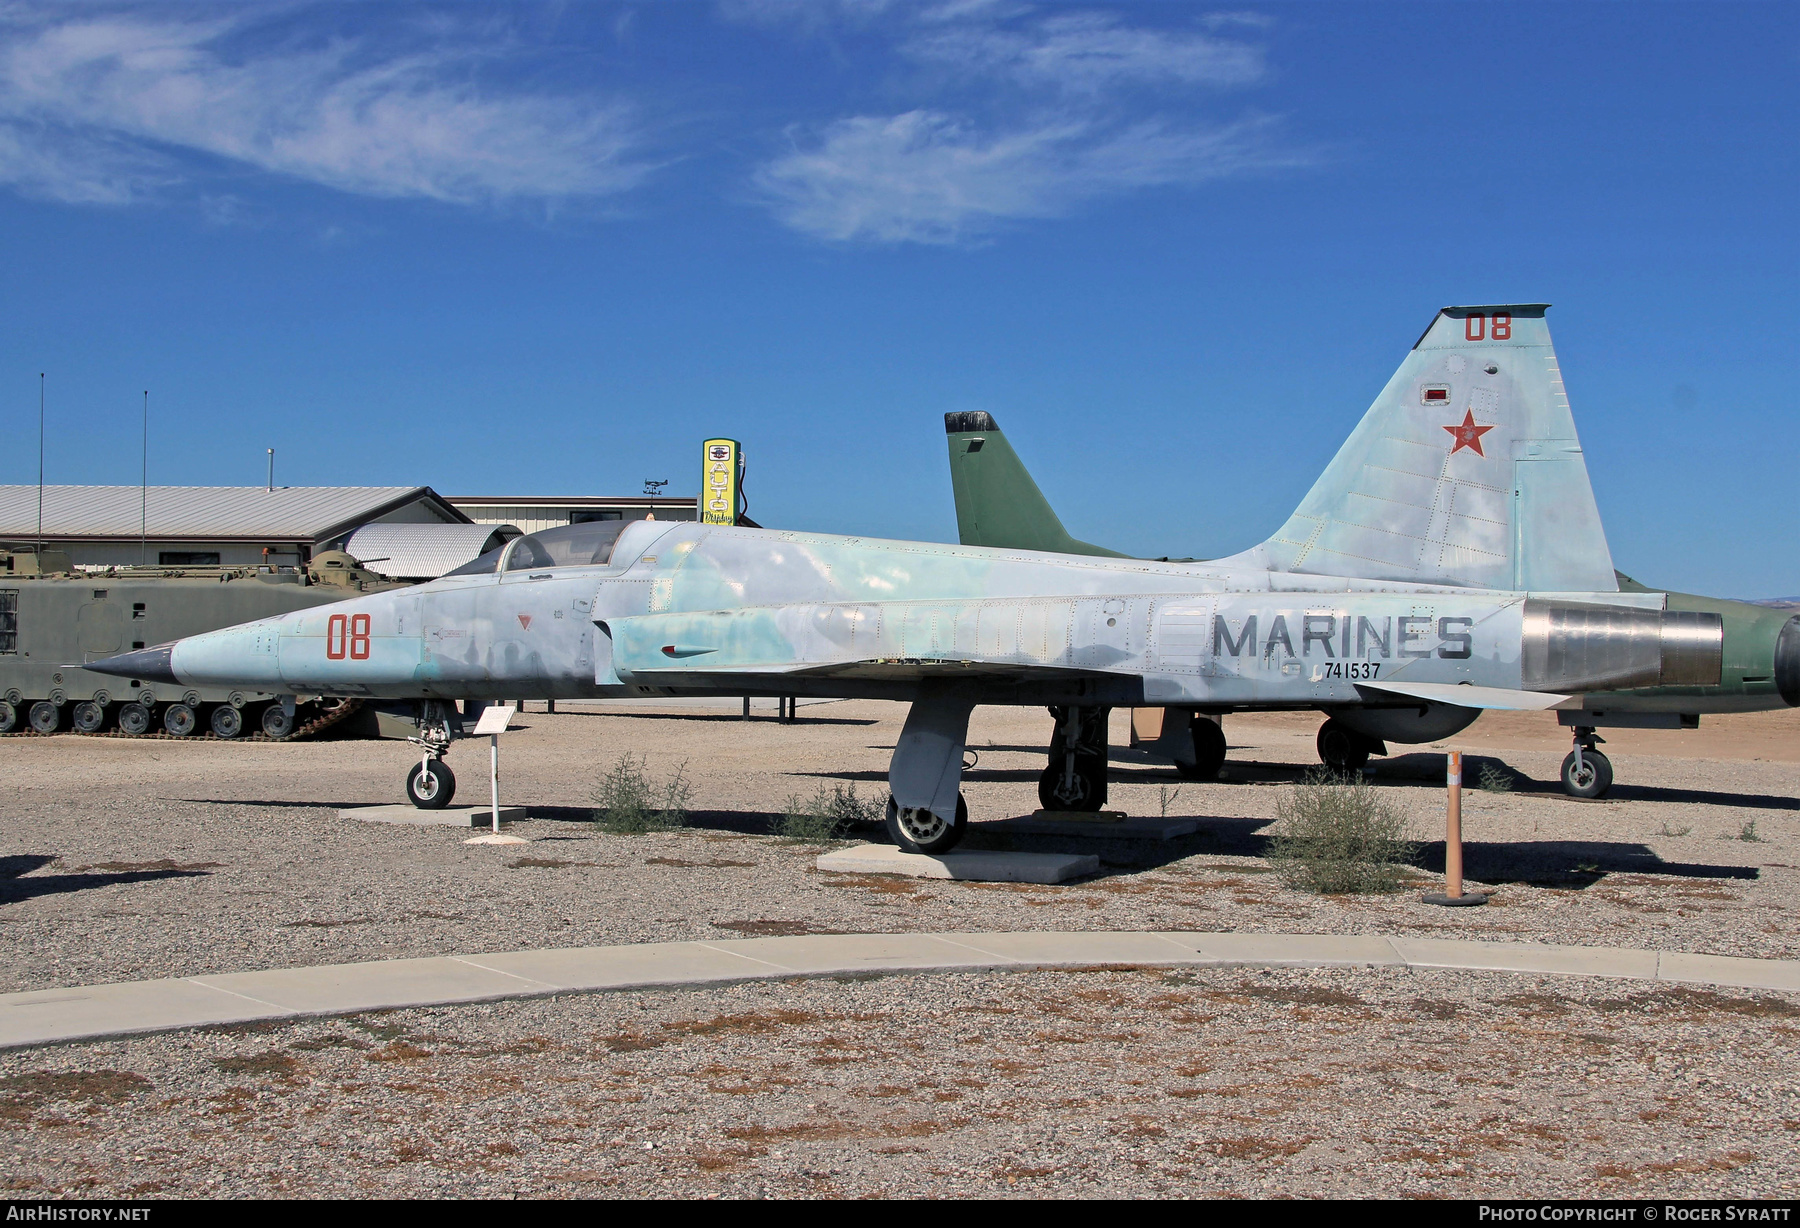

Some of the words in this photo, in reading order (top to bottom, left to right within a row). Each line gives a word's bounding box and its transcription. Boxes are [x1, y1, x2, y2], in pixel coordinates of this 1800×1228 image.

[1466, 312, 1511, 341] 08
[709, 461, 730, 511] AUTO
[704, 510, 733, 525] Display
[327, 613, 371, 660] 08
[1213, 614, 1473, 659] MARINES
[1325, 662, 1381, 679] 741537
